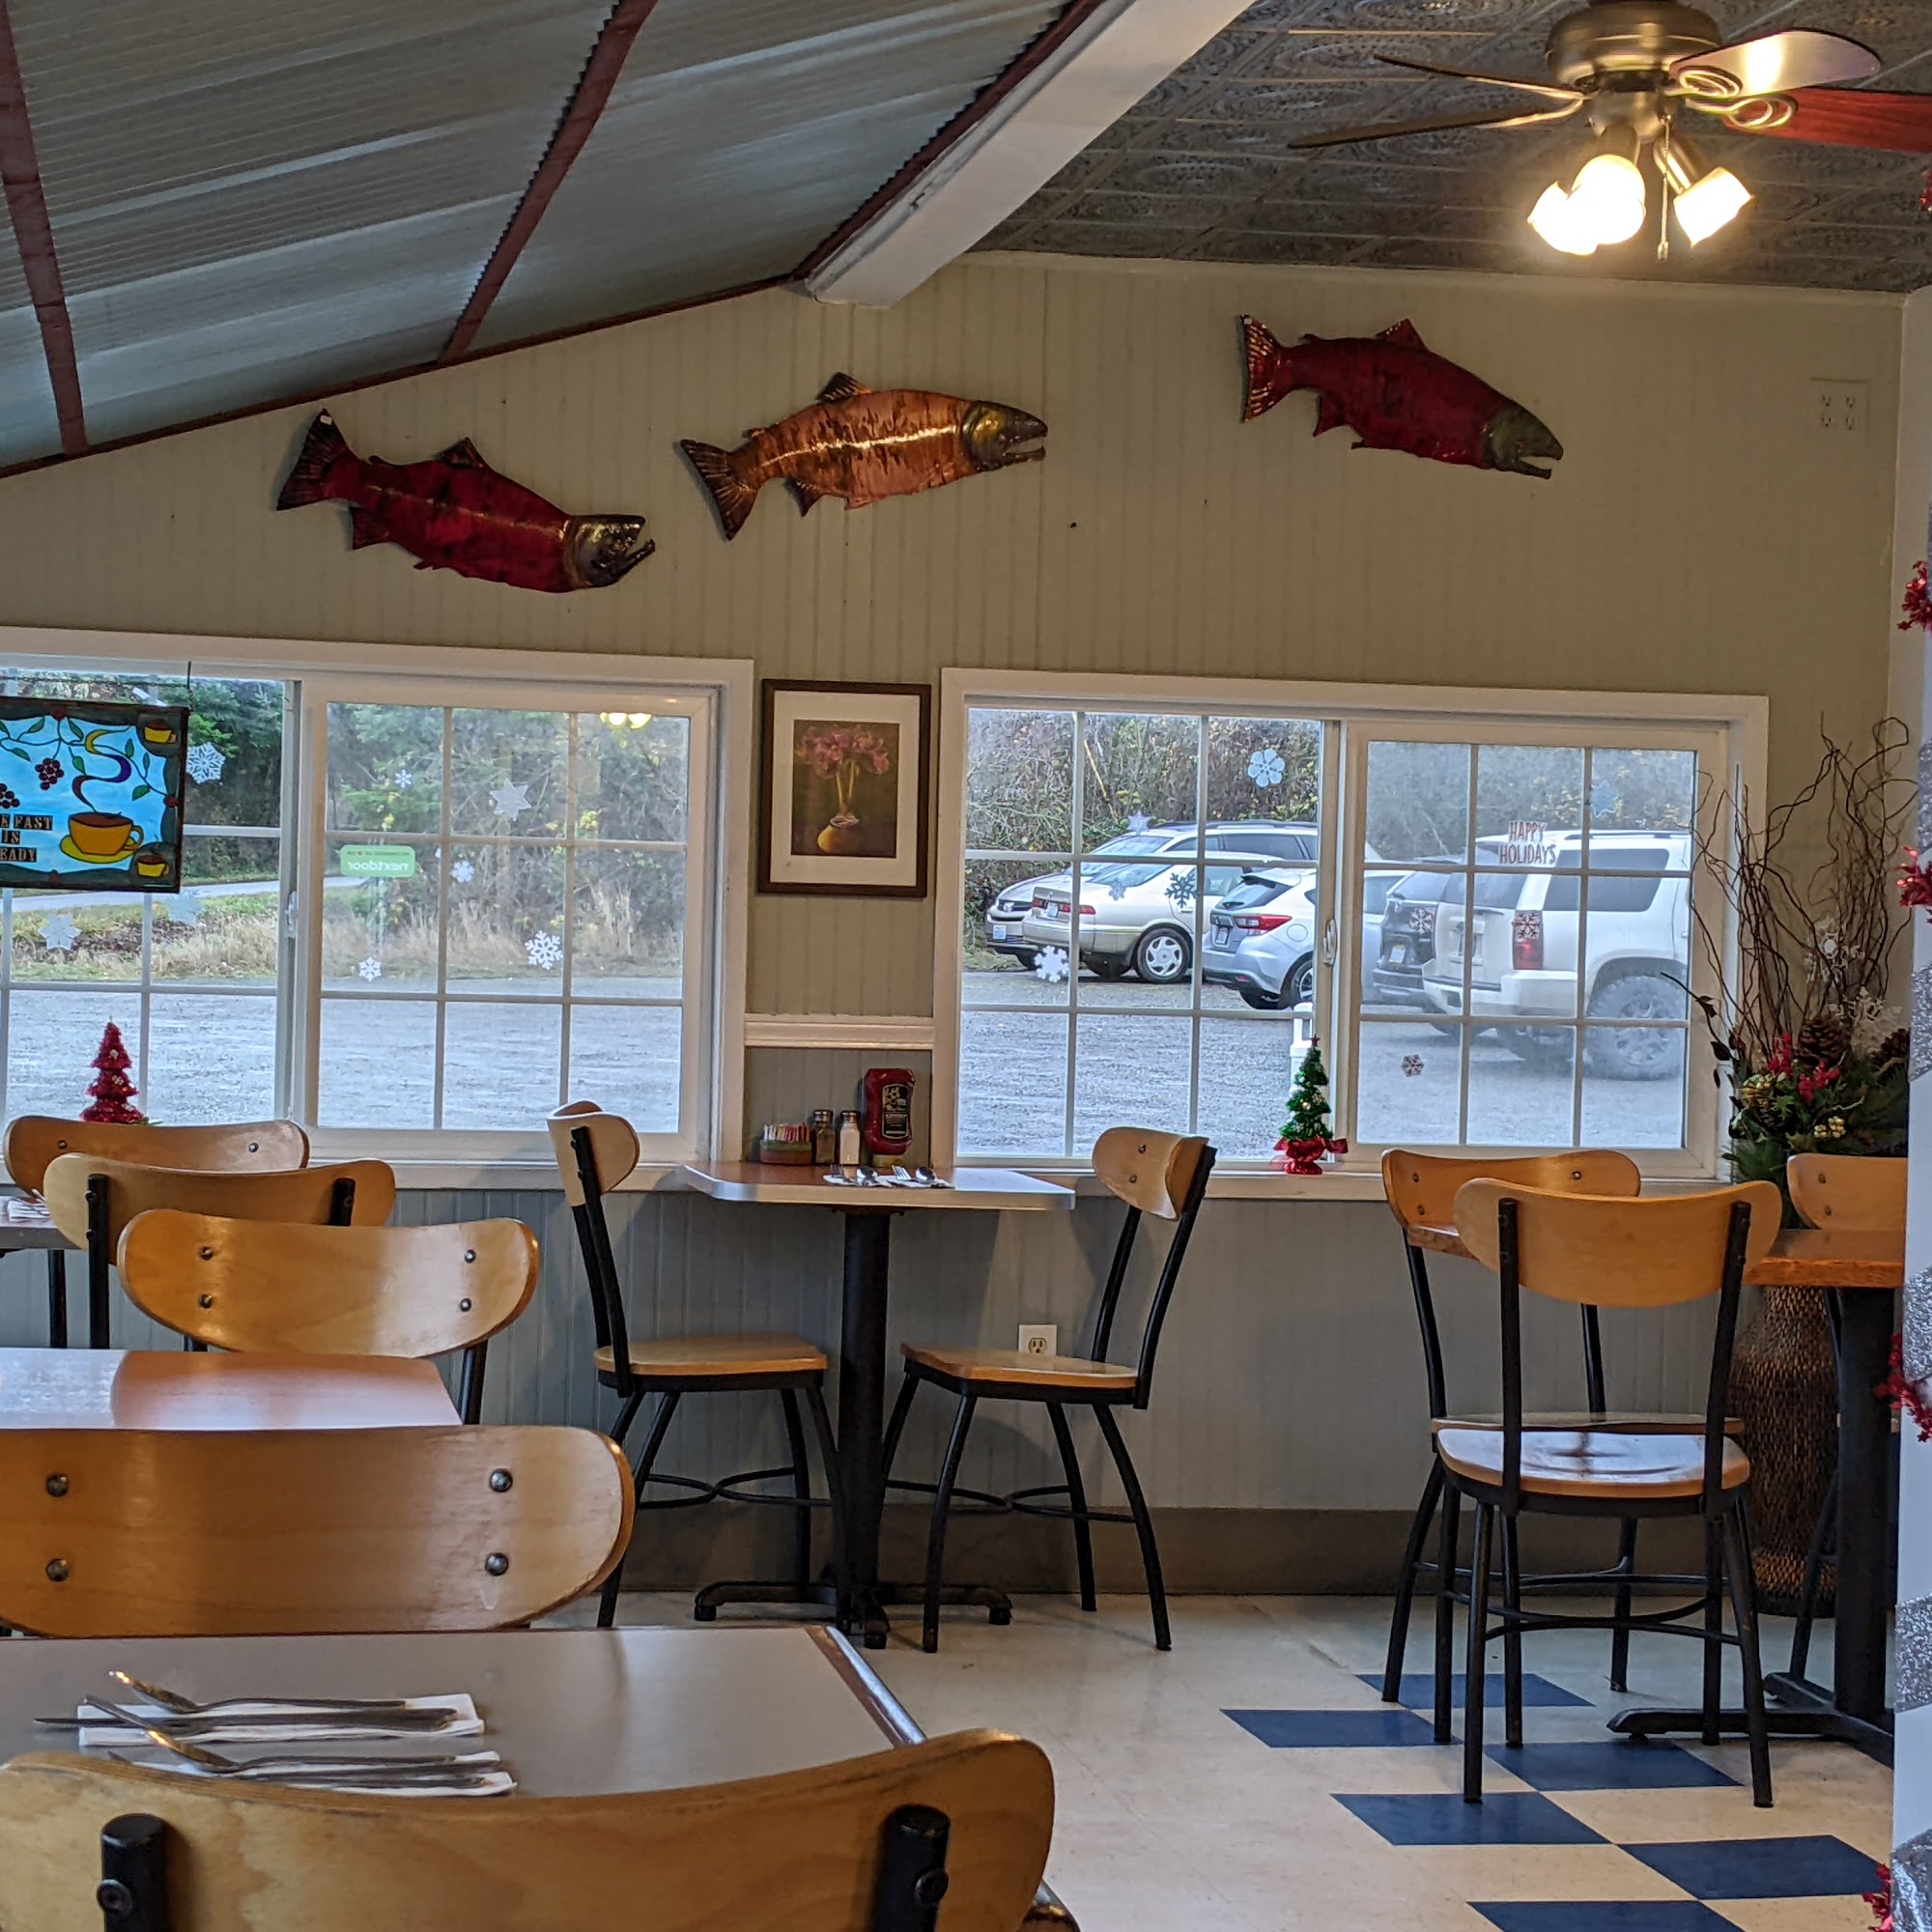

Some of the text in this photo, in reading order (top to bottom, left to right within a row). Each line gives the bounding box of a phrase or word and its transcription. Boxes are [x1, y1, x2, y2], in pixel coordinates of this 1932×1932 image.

[15, 815, 53, 830] FAST
[1509, 820, 1548, 842] HAPPY
[4, 831, 19, 843] IS
[1499, 843, 1557, 865] HOLIDAYS
